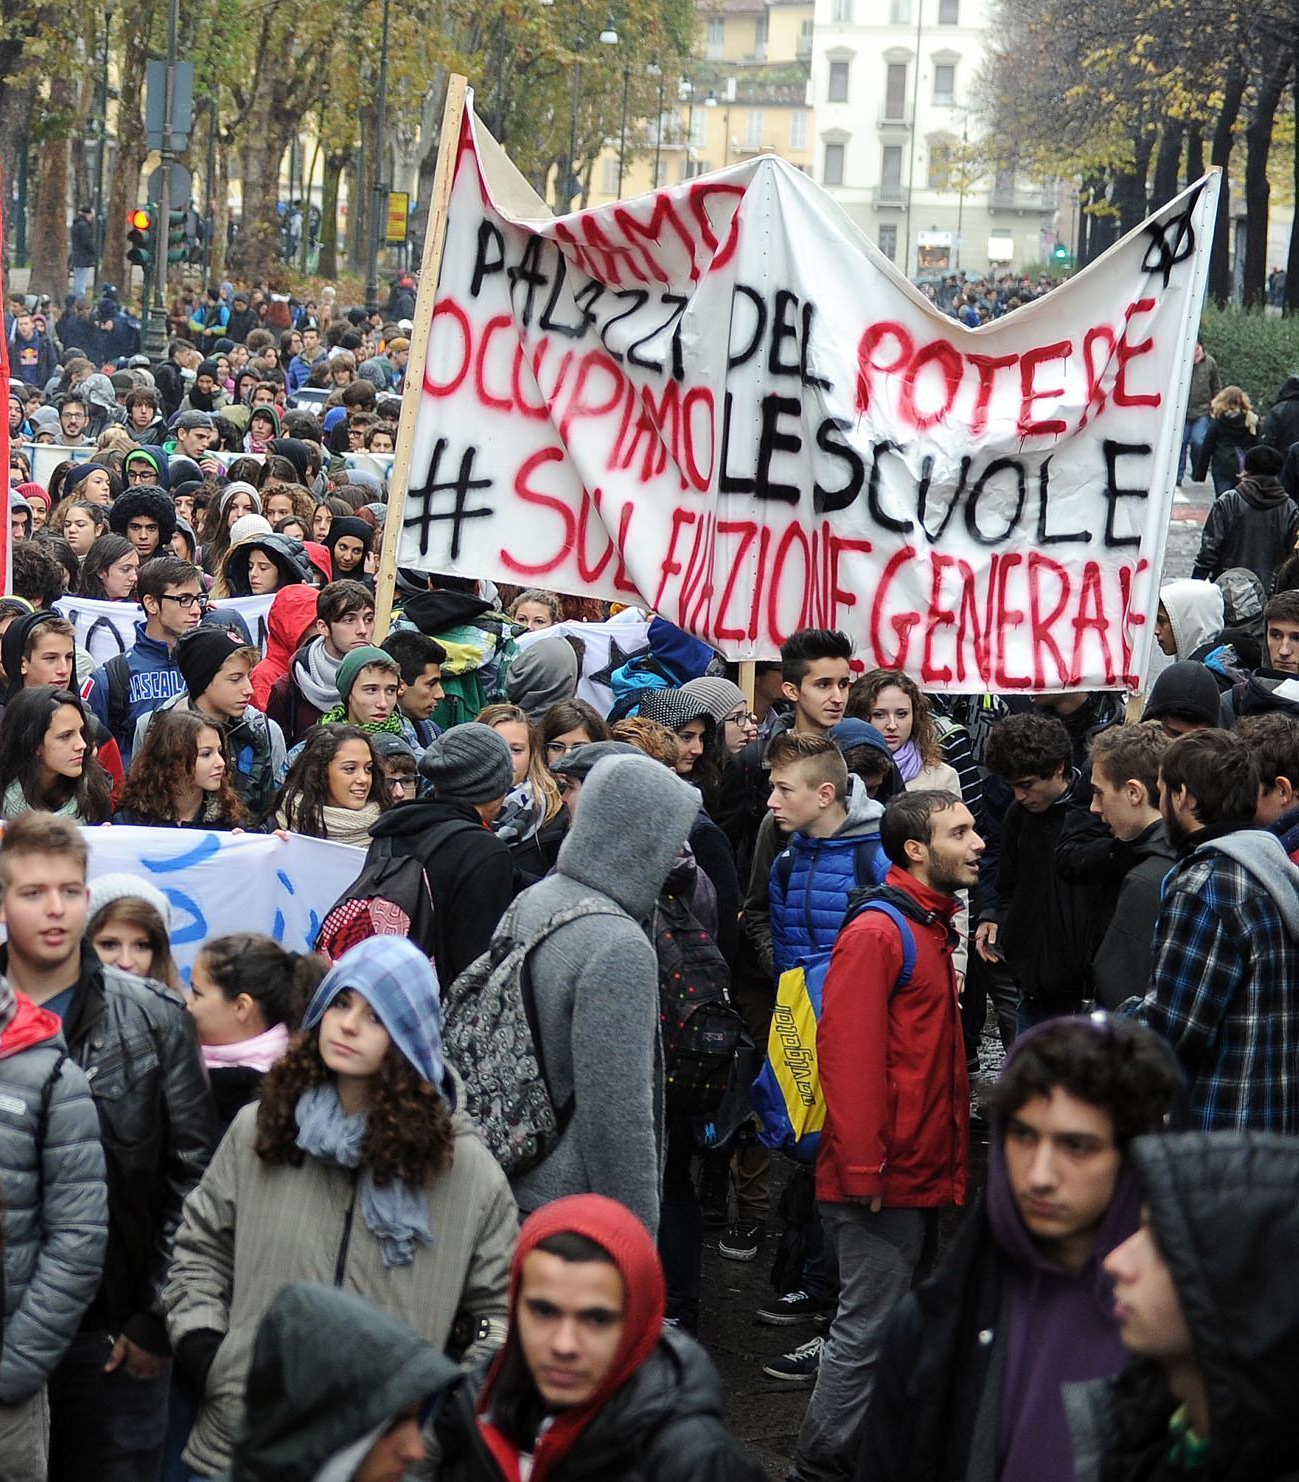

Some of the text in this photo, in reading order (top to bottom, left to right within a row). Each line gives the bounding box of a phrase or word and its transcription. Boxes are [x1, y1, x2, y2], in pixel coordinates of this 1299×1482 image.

[728, 284, 832, 391] DEL
[854, 297, 1162, 436] POTERE
[814, 417, 1151, 547] SCUOLE
